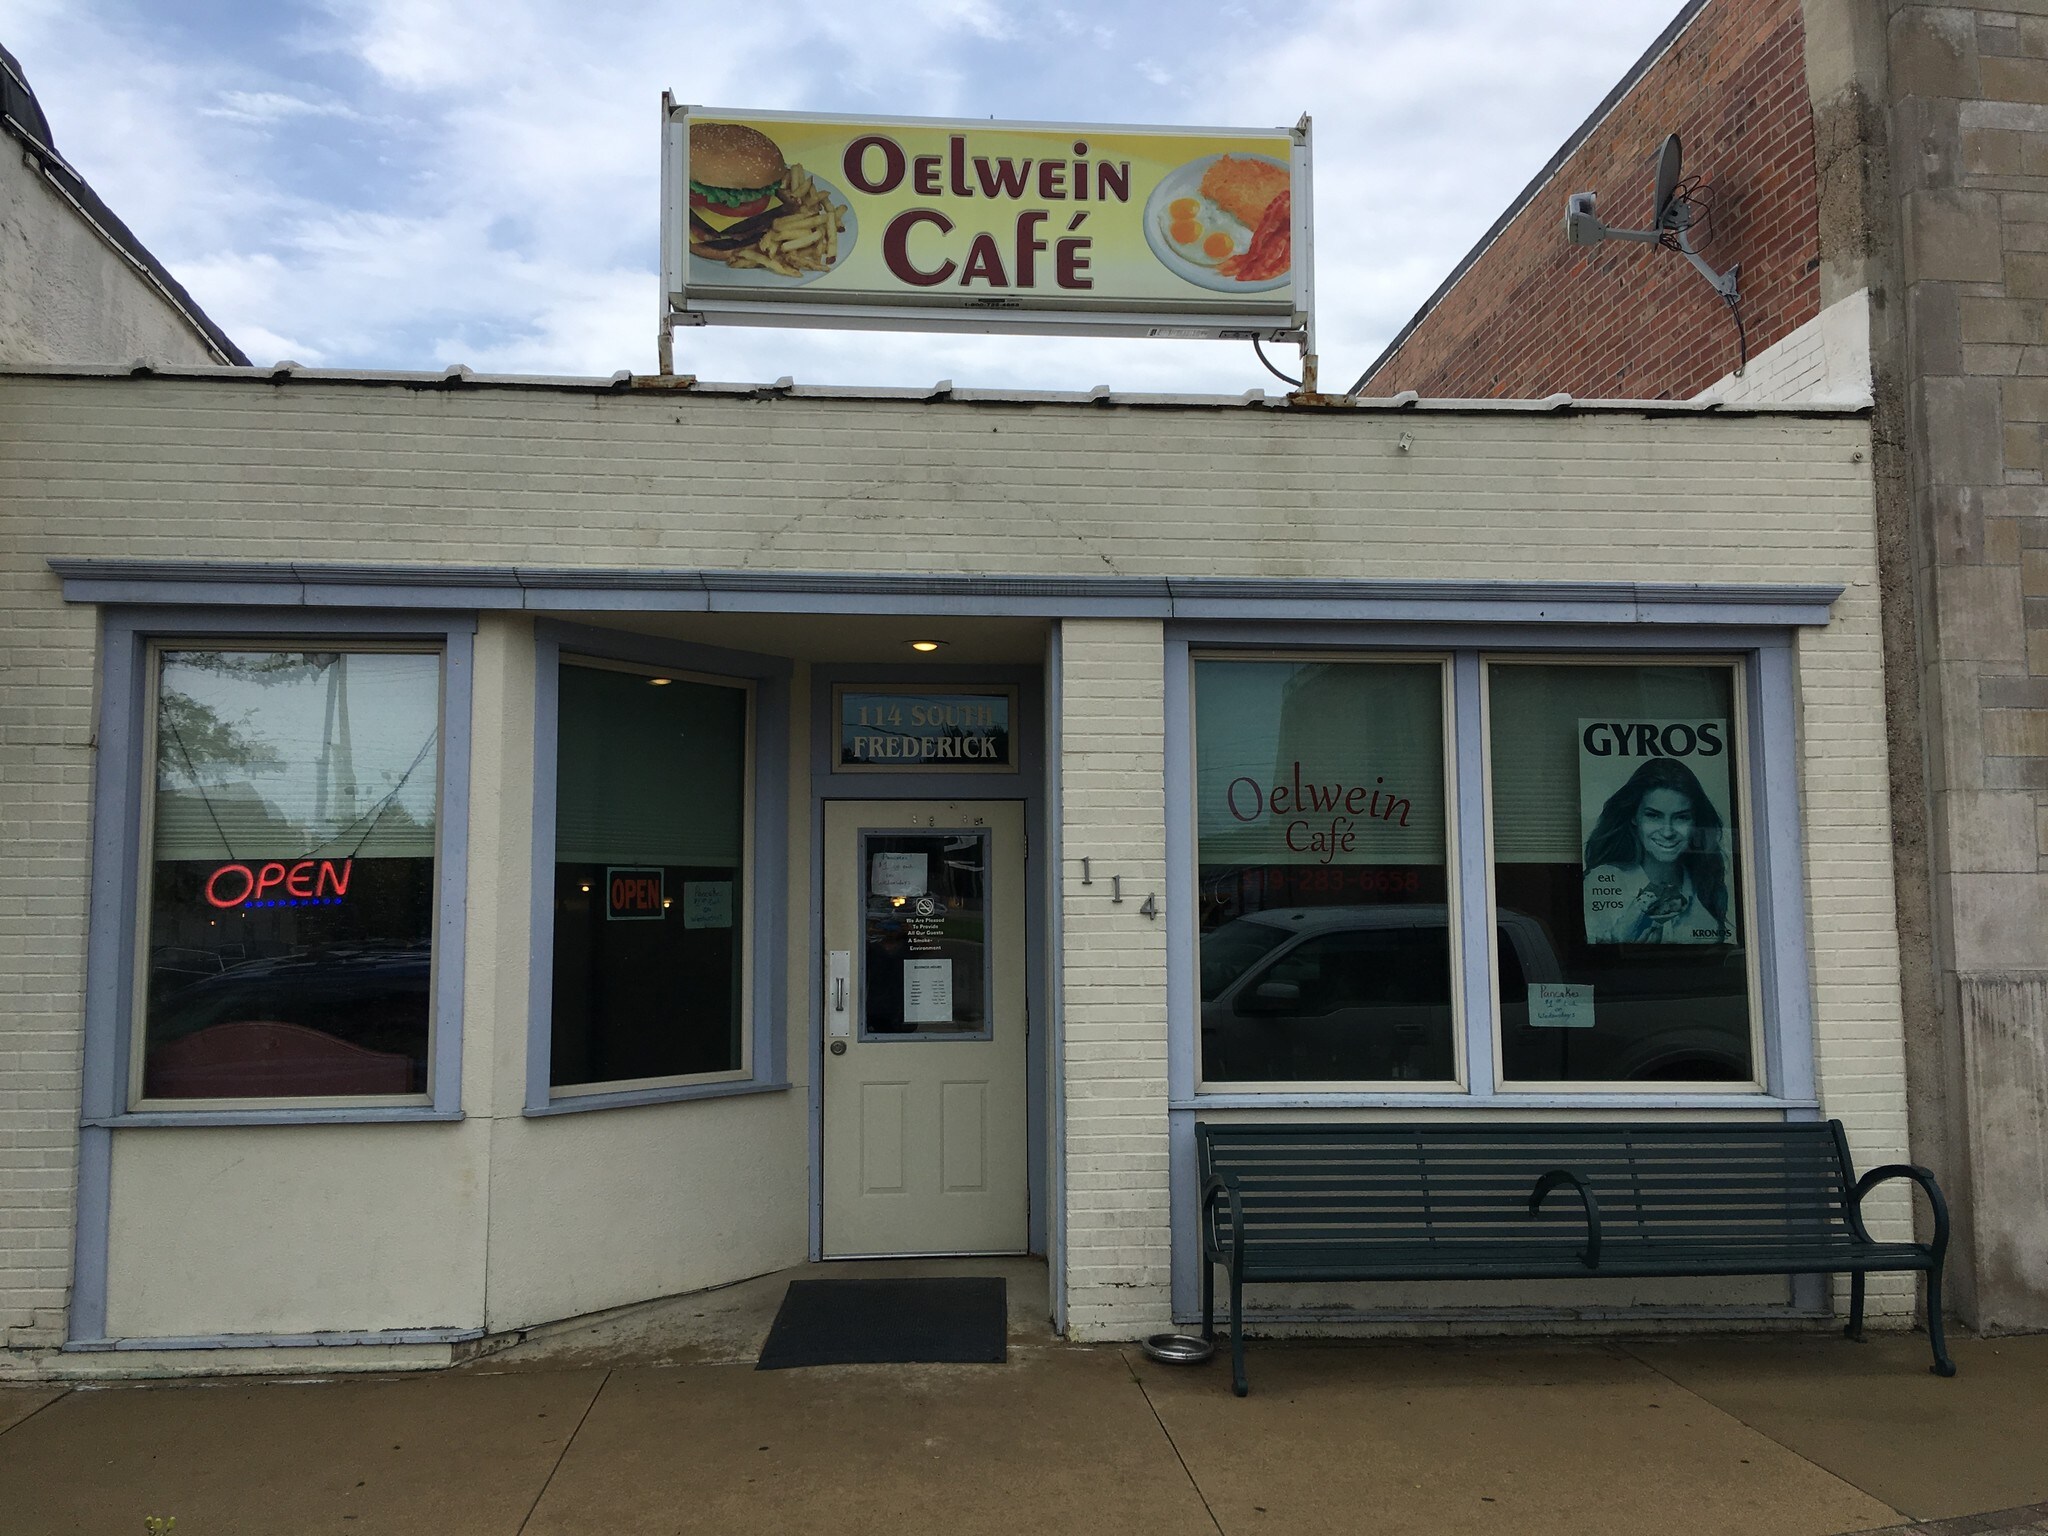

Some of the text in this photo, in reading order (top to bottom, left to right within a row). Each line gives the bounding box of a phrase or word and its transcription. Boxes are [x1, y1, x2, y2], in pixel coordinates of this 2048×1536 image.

[859, 704, 993, 727] 114 SOUTH
[853, 736, 998, 758] FREDERICK
[1583, 723, 1723, 757] GYROS
[1228, 761, 1411, 827] Oelwein
[1285, 816, 1355, 864] Café
[204, 859, 353, 909] OPEN
[1597, 874, 1616, 882] eat
[611, 878, 660, 910] OPEN
[1592, 887, 1622, 896] more
[1591, 901, 1624, 911] gyros
[1692, 929, 1732, 937] KRONOS
